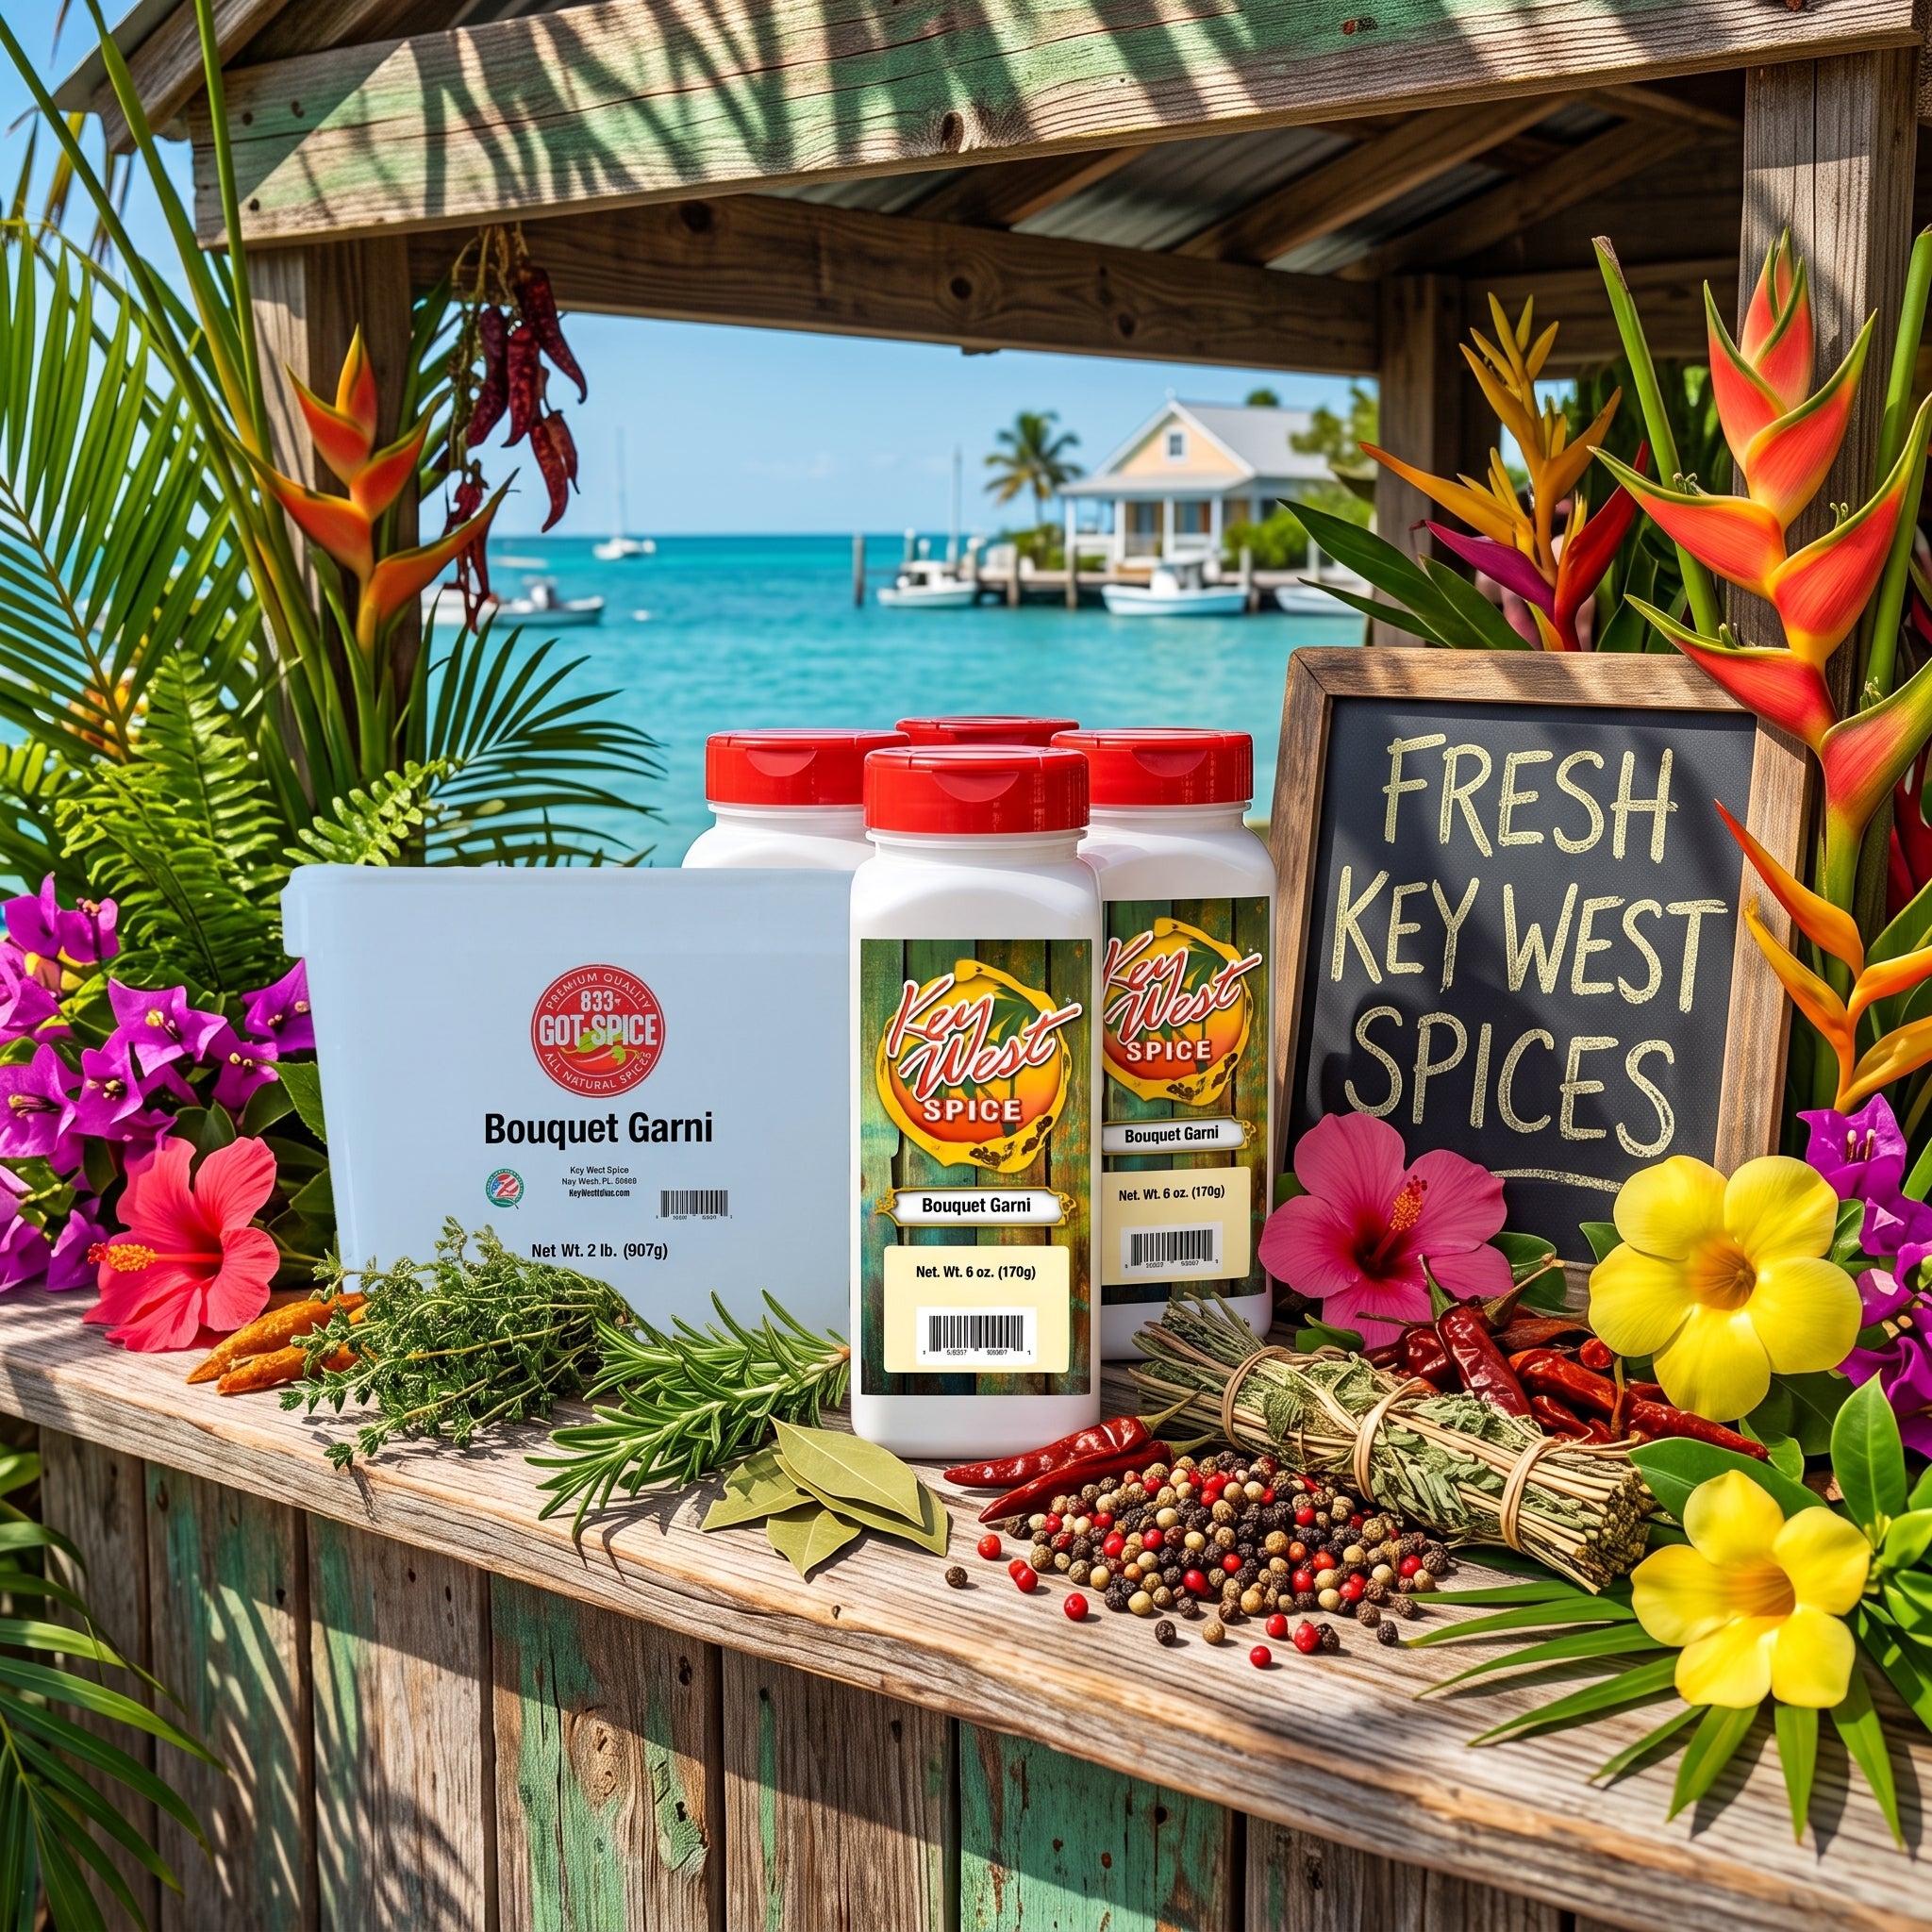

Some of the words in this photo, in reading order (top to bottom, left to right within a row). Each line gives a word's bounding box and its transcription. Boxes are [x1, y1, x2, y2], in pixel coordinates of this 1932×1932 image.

[1382, 733, 1678, 862] FRESH
[1331, 866, 1480, 993] KEY
[1502, 882, 1728, 1013] WEST
[545, 973, 598, 1009] PREMIUM
[1104, 953, 1262, 1045] West
[886, 973, 995, 1058] Key
[897, 1002, 1083, 1102] West
[1126, 1041, 1211, 1061] SPICE
[545, 1052, 561, 1073] ALL
[562, 1070, 616, 1090] NATURAL
[1344, 1006, 1675, 1158] SPICES
[923, 1099, 1022, 1121] SPICE
[485, 1113, 619, 1150] Bouquet
[628, 1111, 713, 1143] Garni
[1124, 1127, 1181, 1144] Bouquet
[1184, 1125, 1219, 1141] Garni
[607, 1166, 629, 1175] Spice
[922, 1197, 986, 1215] Bouquet
[990, 1197, 1031, 1213] Garni
[1119, 1190, 1141, 1201] Net.
[1142, 1188, 1160, 1200] Wt.
[1163, 1188, 1171, 1199] 6
[1173, 1189, 1189, 1198] oz.
[1191, 1185, 1225, 1200] (170g)
[531, 1244, 556, 1257] Net
[561, 1243, 583, 1257] Wt.
[587, 1243, 596, 1257] 2
[600, 1243, 617, 1257] lb.
[623, 1242, 668, 1260] (907g)
[916, 1266, 940, 1277] Net.
[943, 1266, 962, 1277] Wt.
[965, 1266, 974, 1277] 6
[976, 1268, 994, 1277] oz.
[998, 1265, 1036, 1280] (170g)
